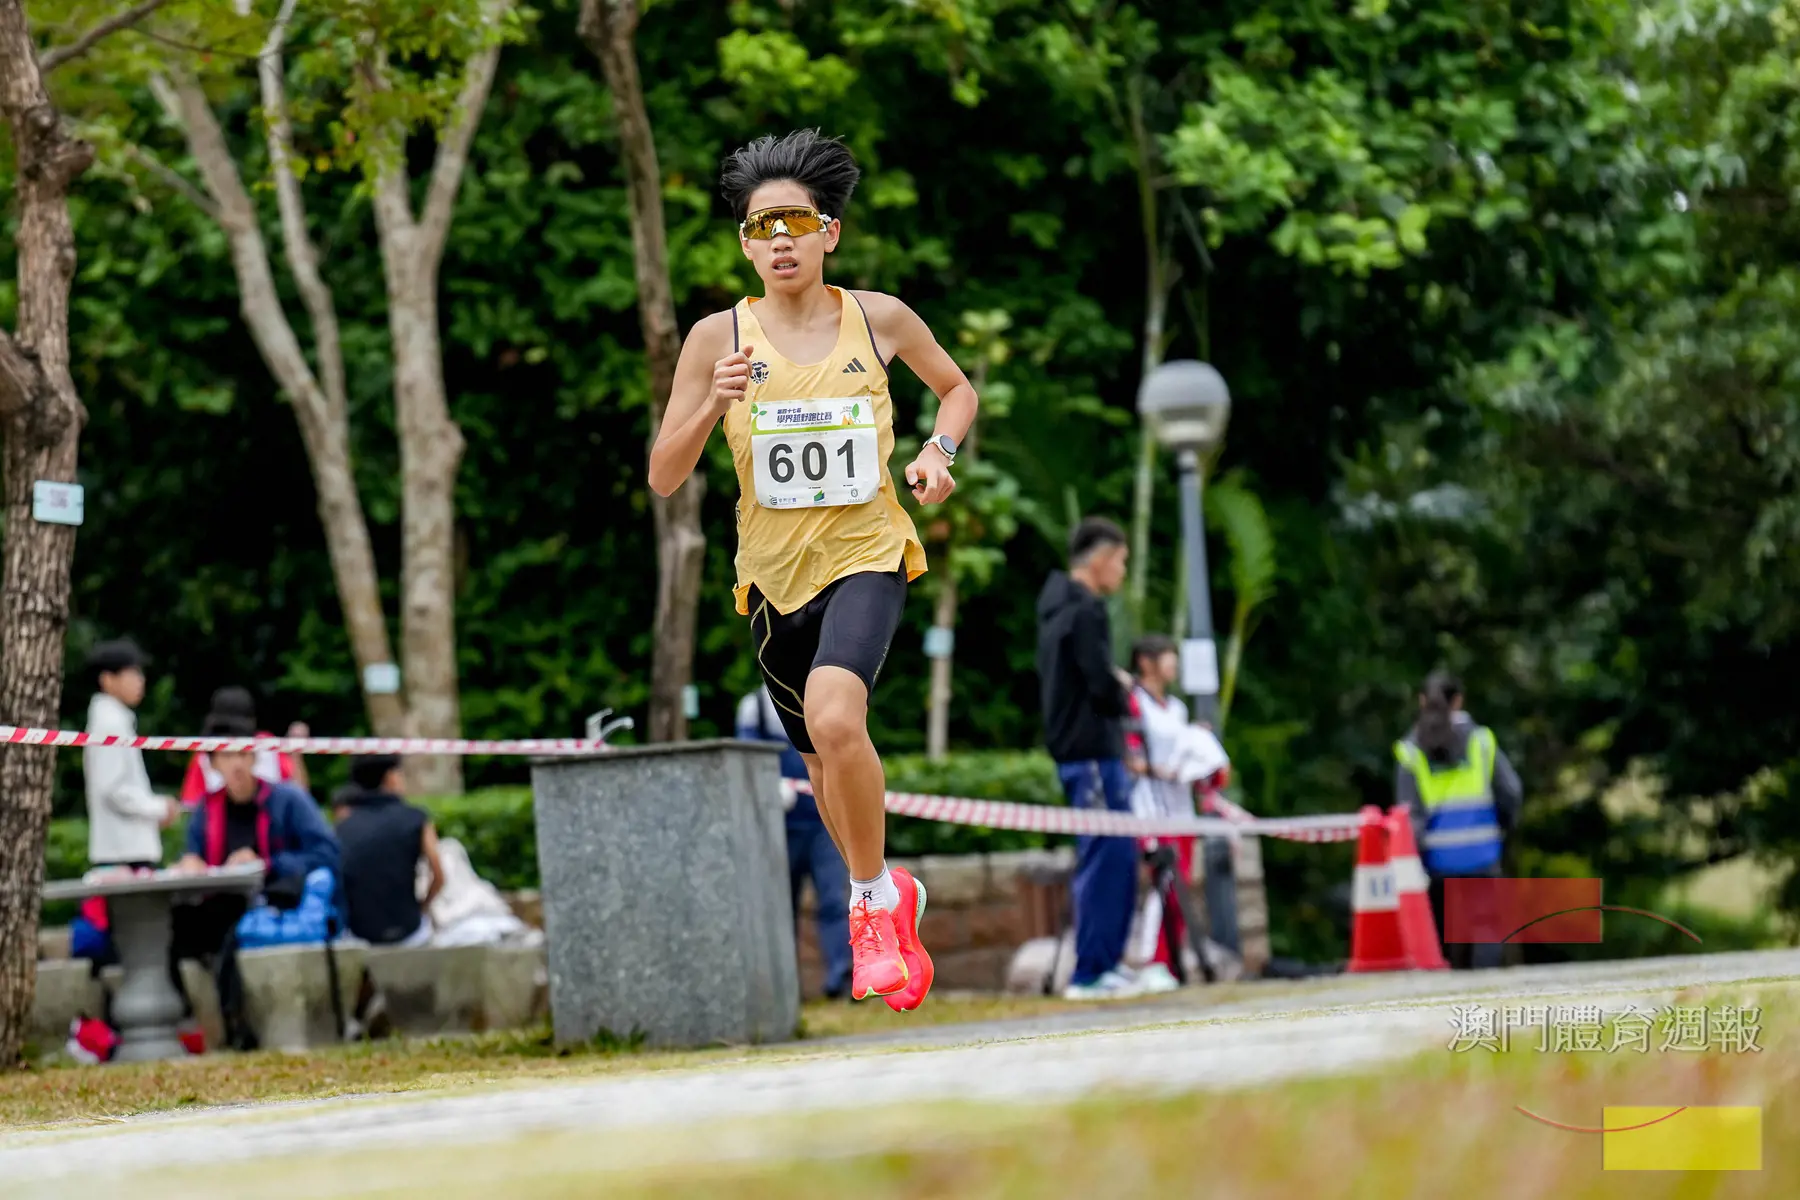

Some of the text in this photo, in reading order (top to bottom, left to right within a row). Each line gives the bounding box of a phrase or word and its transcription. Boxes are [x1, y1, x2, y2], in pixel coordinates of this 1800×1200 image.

[777, 411, 833, 423] 學界越野跑比賽
[769, 438, 855, 483] 601
